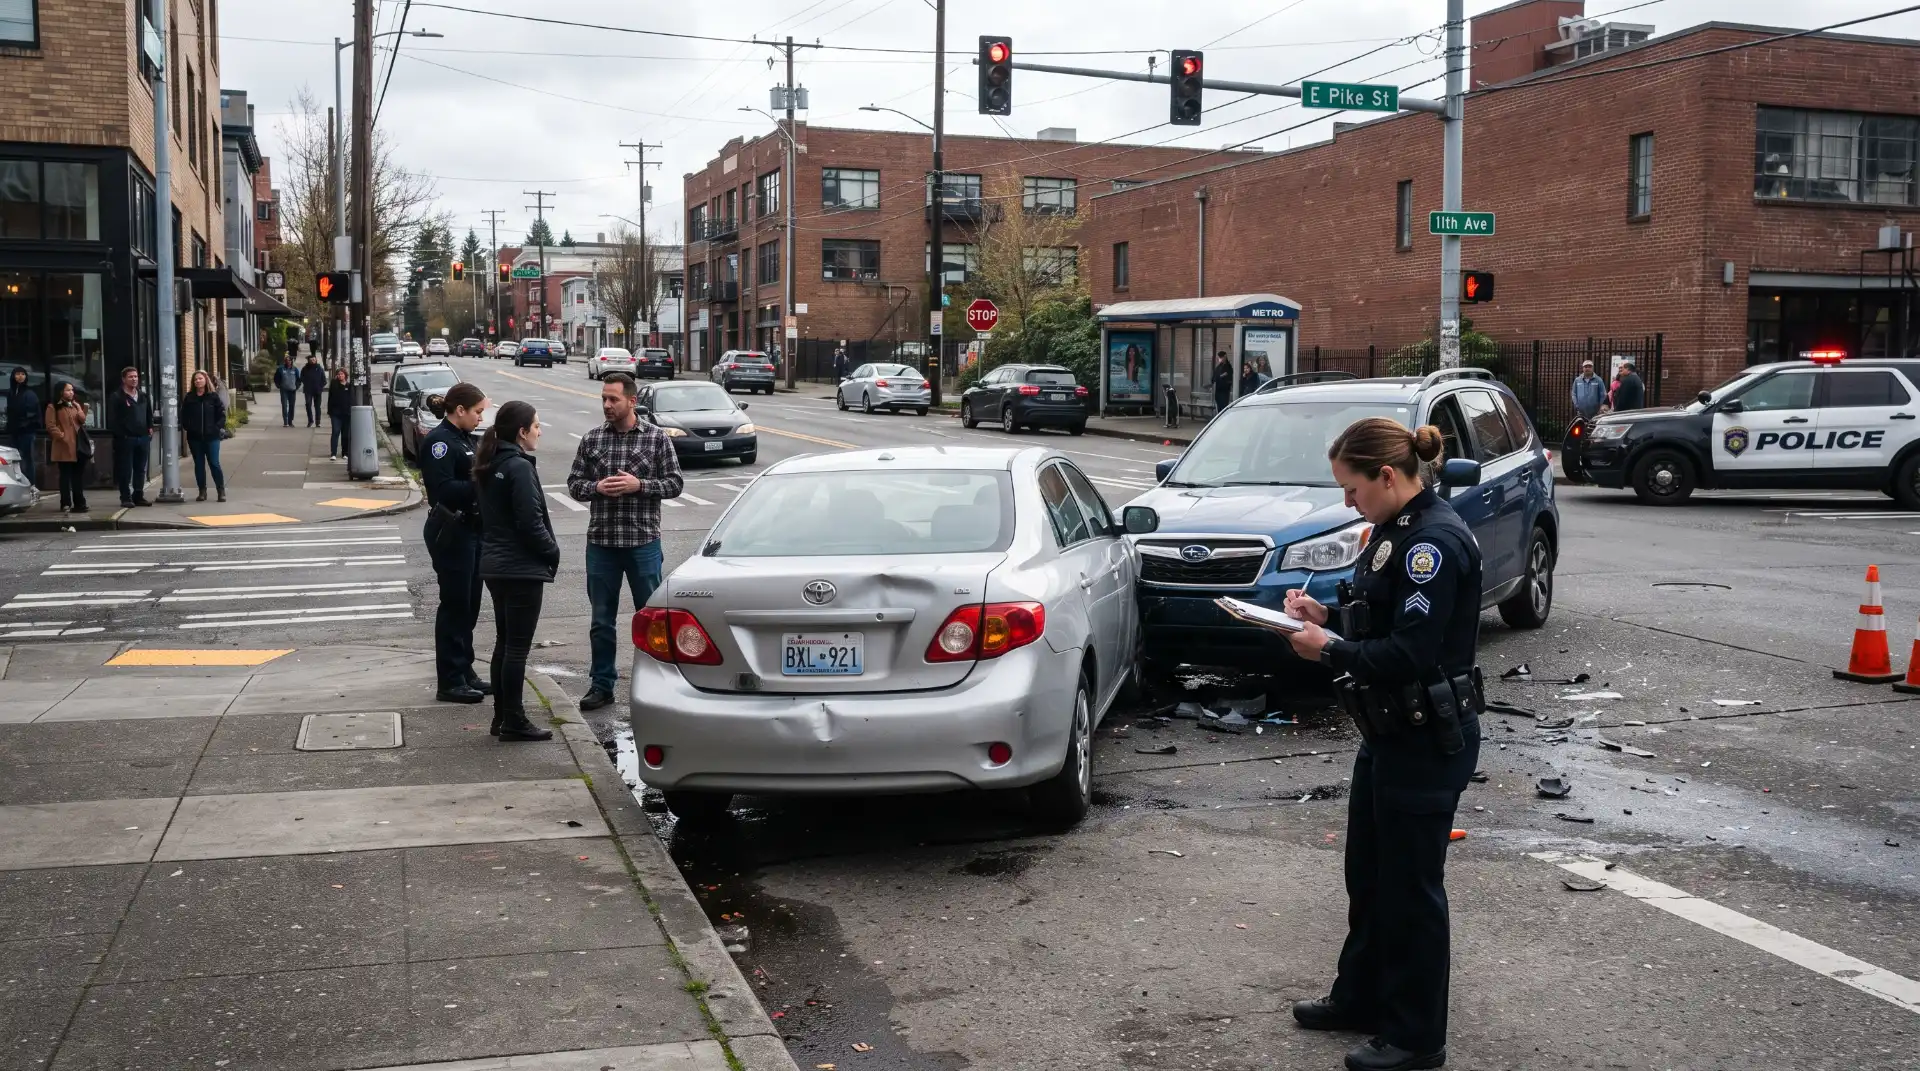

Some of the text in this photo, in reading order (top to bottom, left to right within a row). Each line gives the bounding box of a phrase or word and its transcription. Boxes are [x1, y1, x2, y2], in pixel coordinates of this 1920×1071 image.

[1310, 86, 1389, 107] E Pike St
[1436, 215, 1487, 231] 11th Ave
[969, 309, 997, 321] STOP
[1252, 309, 1284, 317] METRO
[1755, 430, 1886, 450] POLICE
[786, 646, 858, 668] BXL 921
